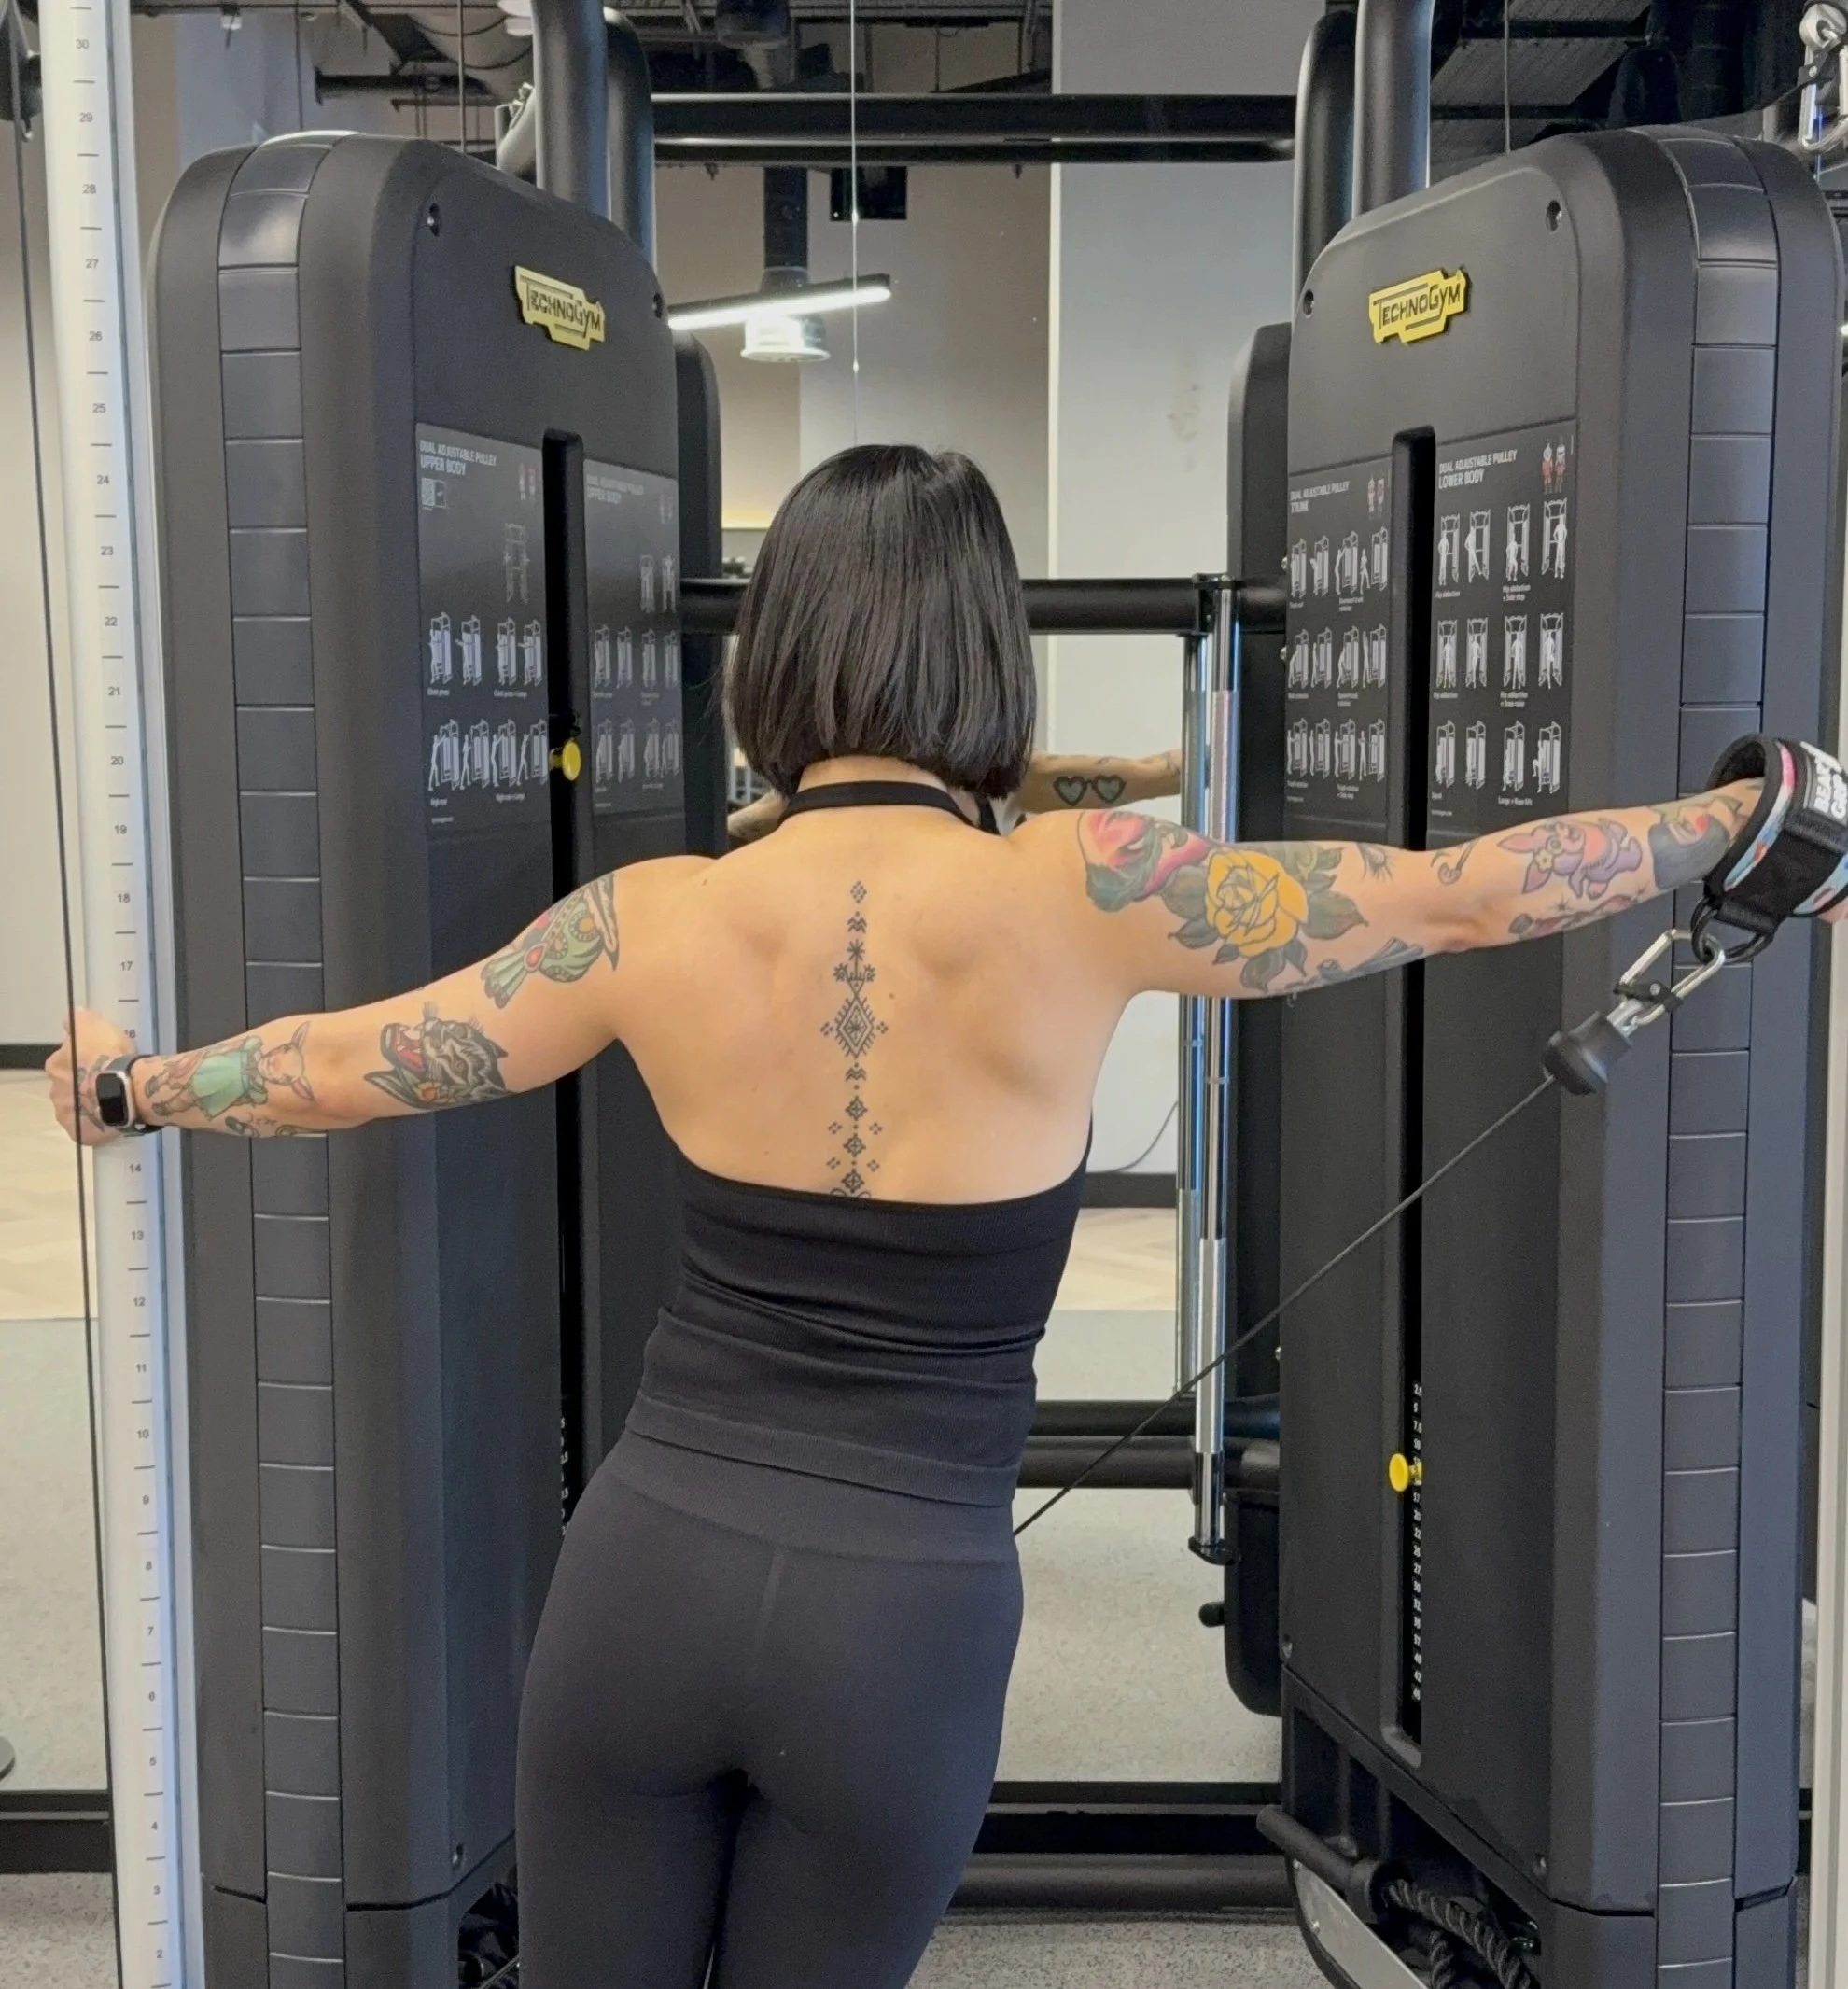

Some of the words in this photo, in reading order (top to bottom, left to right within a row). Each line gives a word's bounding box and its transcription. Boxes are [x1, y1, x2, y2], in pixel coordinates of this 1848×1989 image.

[76, 38, 90, 49] 30
[78, 111, 94, 123] 29
[82, 183, 97, 195] 28
[85, 258, 100, 270] 27
[520, 274, 601, 339] TECHNOGYM
[1373, 283, 1461, 331] TECHNOGYM
[89, 330, 104, 342] 26
[91, 402, 107, 414] 25
[437, 443, 475, 463] ADJUSTABLE
[475, 451, 497, 466] PULLEY
[1455, 454, 1492, 471] ADJUSTABLE
[1492, 449, 1518, 464] PULLEY
[420, 454, 445, 471] UPPER
[446, 459, 467, 476] BODY
[96, 474, 111, 485] 24
[1438, 471, 1463, 489] LOWER
[1463, 469, 1486, 485] BODY
[100, 545, 115, 556] 23
[104, 615, 119, 627] 22
[107, 685, 121, 697] 21
[109, 755, 125, 766] 20
[114, 824, 128, 835] 19
[117, 892, 132, 903] 18
[120, 960, 133, 972] 17
[128, 1163, 143, 1173] 14
[131, 1229, 145, 1240] 13
[133, 1296, 147, 1308] 12
[135, 1363, 147, 1373] 11
[136, 1428, 150, 1440] 10
[142, 1494, 150, 1506] 9
[145, 1560, 153, 1572] 8
[147, 1625, 155, 1636] 7
[147, 1690, 157, 1702] 6
[148, 1756, 158, 1767] 5
[150, 1821, 159, 1831] 4
[153, 1884, 161, 1896] 3
[156, 1949, 163, 1959] 2
